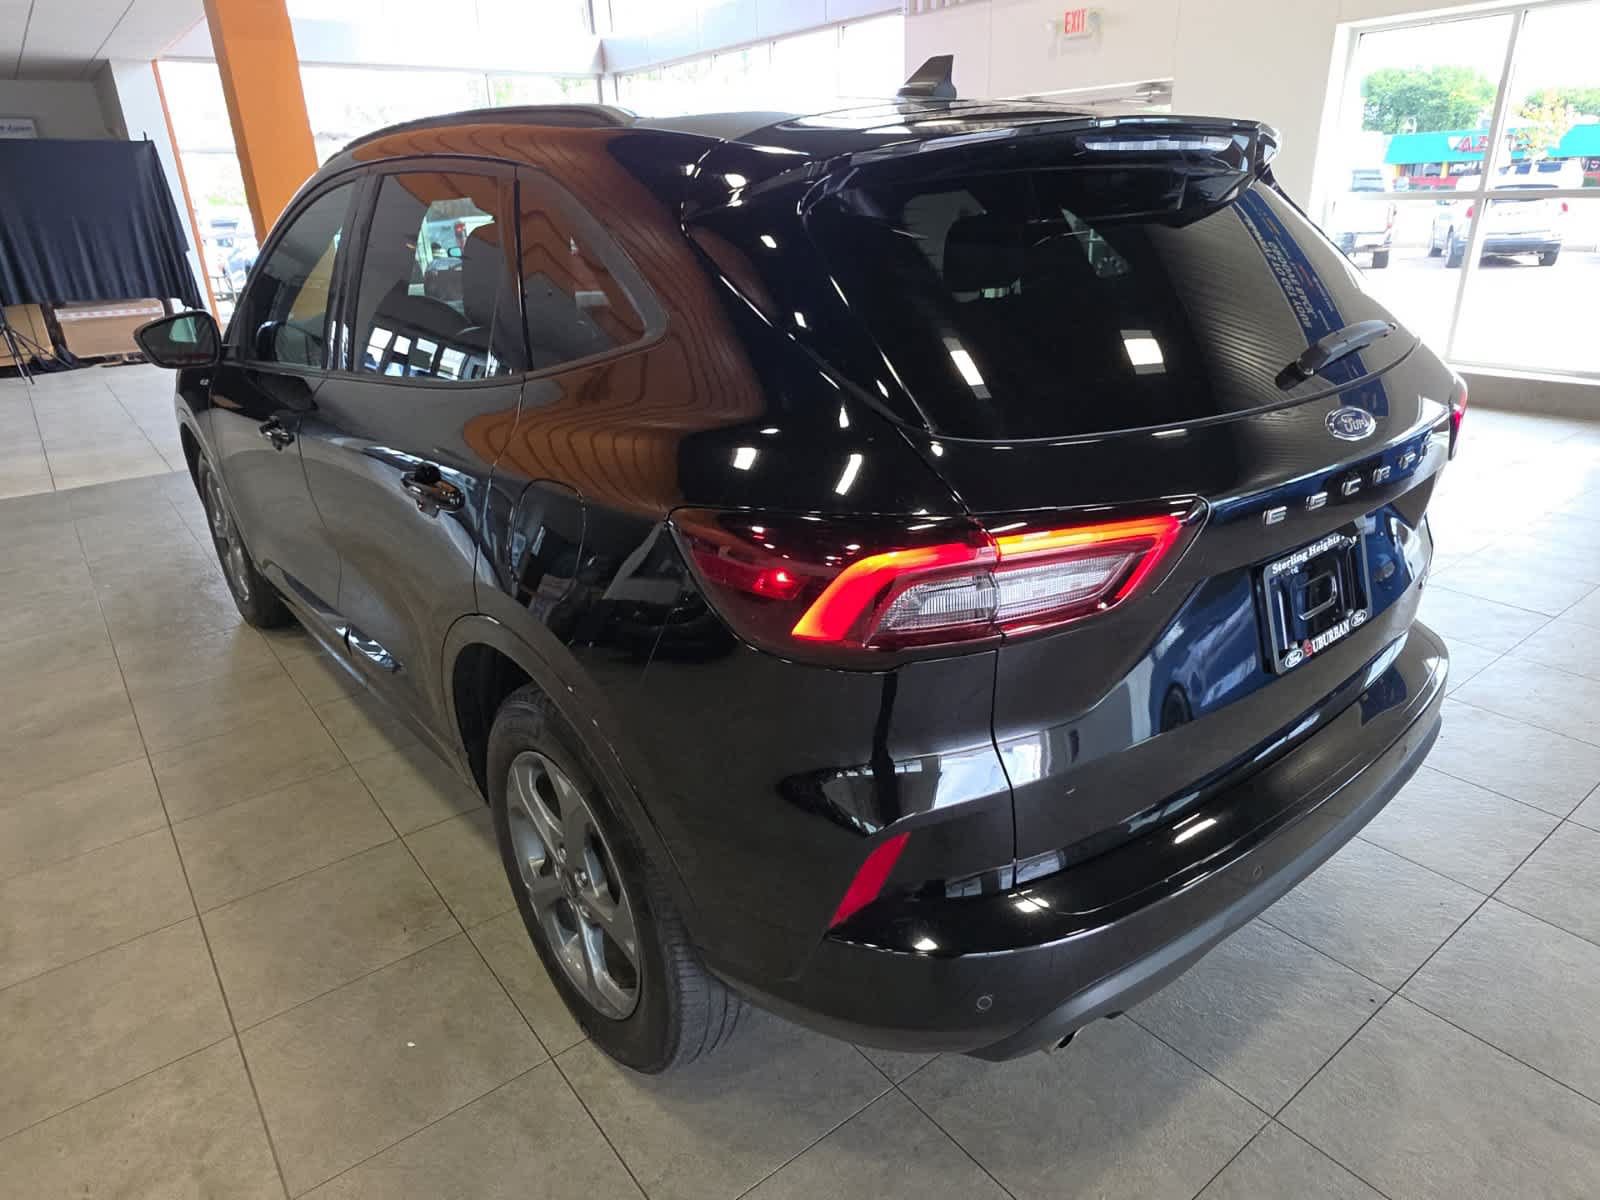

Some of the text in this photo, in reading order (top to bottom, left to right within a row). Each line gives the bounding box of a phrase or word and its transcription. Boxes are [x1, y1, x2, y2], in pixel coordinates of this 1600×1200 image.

[1064, 8, 1088, 34] EXIT
[1271, 535, 1341, 575] Sterling Heights
[1302, 619, 1350, 657] SUBURBAN
